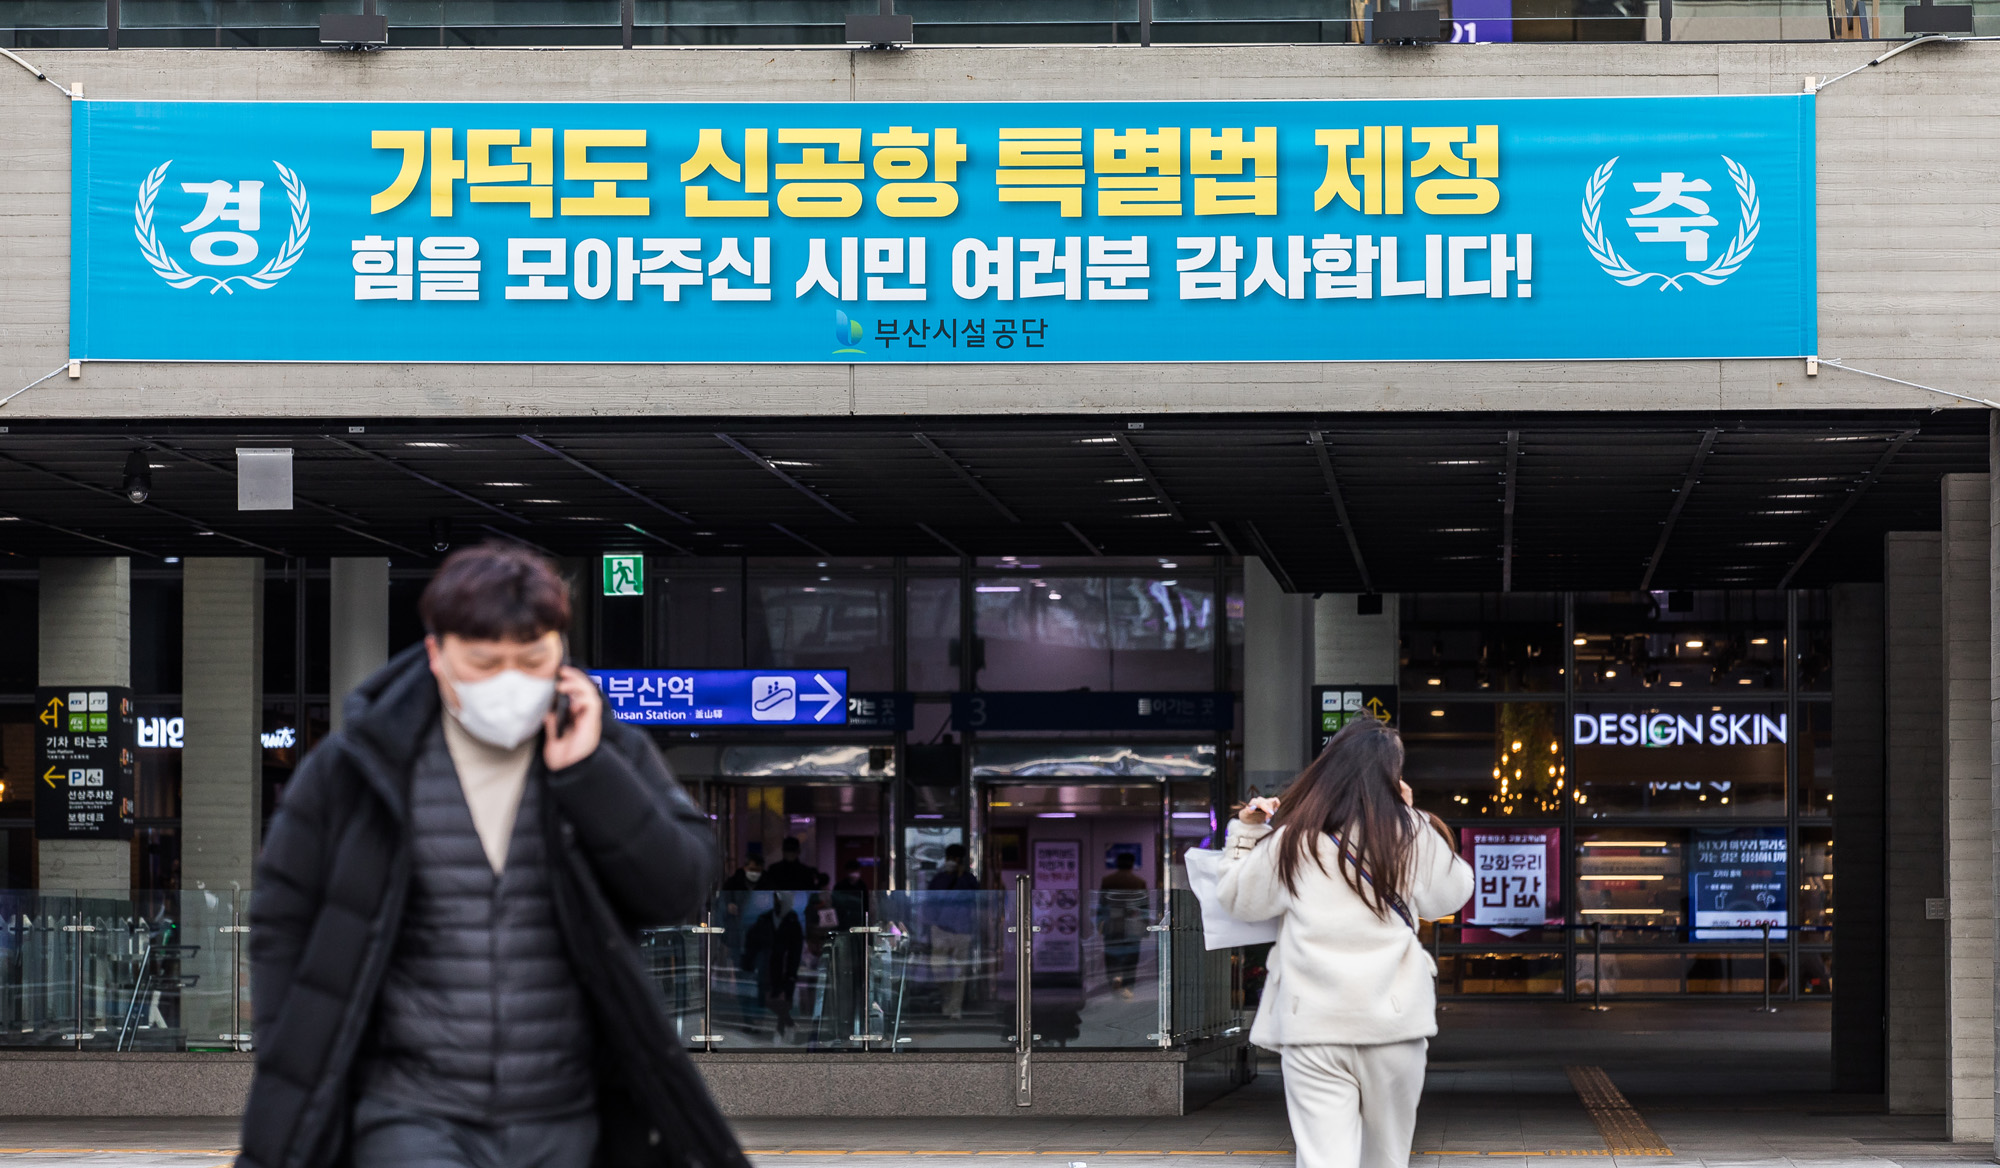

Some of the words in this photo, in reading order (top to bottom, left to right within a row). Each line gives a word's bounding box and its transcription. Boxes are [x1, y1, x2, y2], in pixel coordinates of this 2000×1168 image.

[371, 128, 650, 218] 가덕도
[680, 126, 967, 218] 신공항
[995, 126, 1277, 218] 특별법
[1314, 125, 1500, 215] 제정
[180, 180, 264, 266] 경
[1626, 172, 1718, 261] 축
[351, 235, 482, 301] 힘을
[505, 236, 772, 302] 모아주신
[795, 236, 927, 301] 시민
[952, 235, 1150, 301] 여러분
[1176, 233, 1532, 301] 감사합니다!
[875, 318, 1049, 349] 부산시설공단
[608, 676, 695, 707] 부산역
[646, 709, 687, 721] Station
[969, 698, 987, 726] 3
[46, 736, 69, 748] 기차
[1573, 713, 1704, 745] DESIGN
[1708, 713, 1788, 745] SKIN
[68, 790, 114, 801] 선상주차장
[1480, 854, 1542, 871] 강화유리
[1481, 876, 1541, 908] 반값
